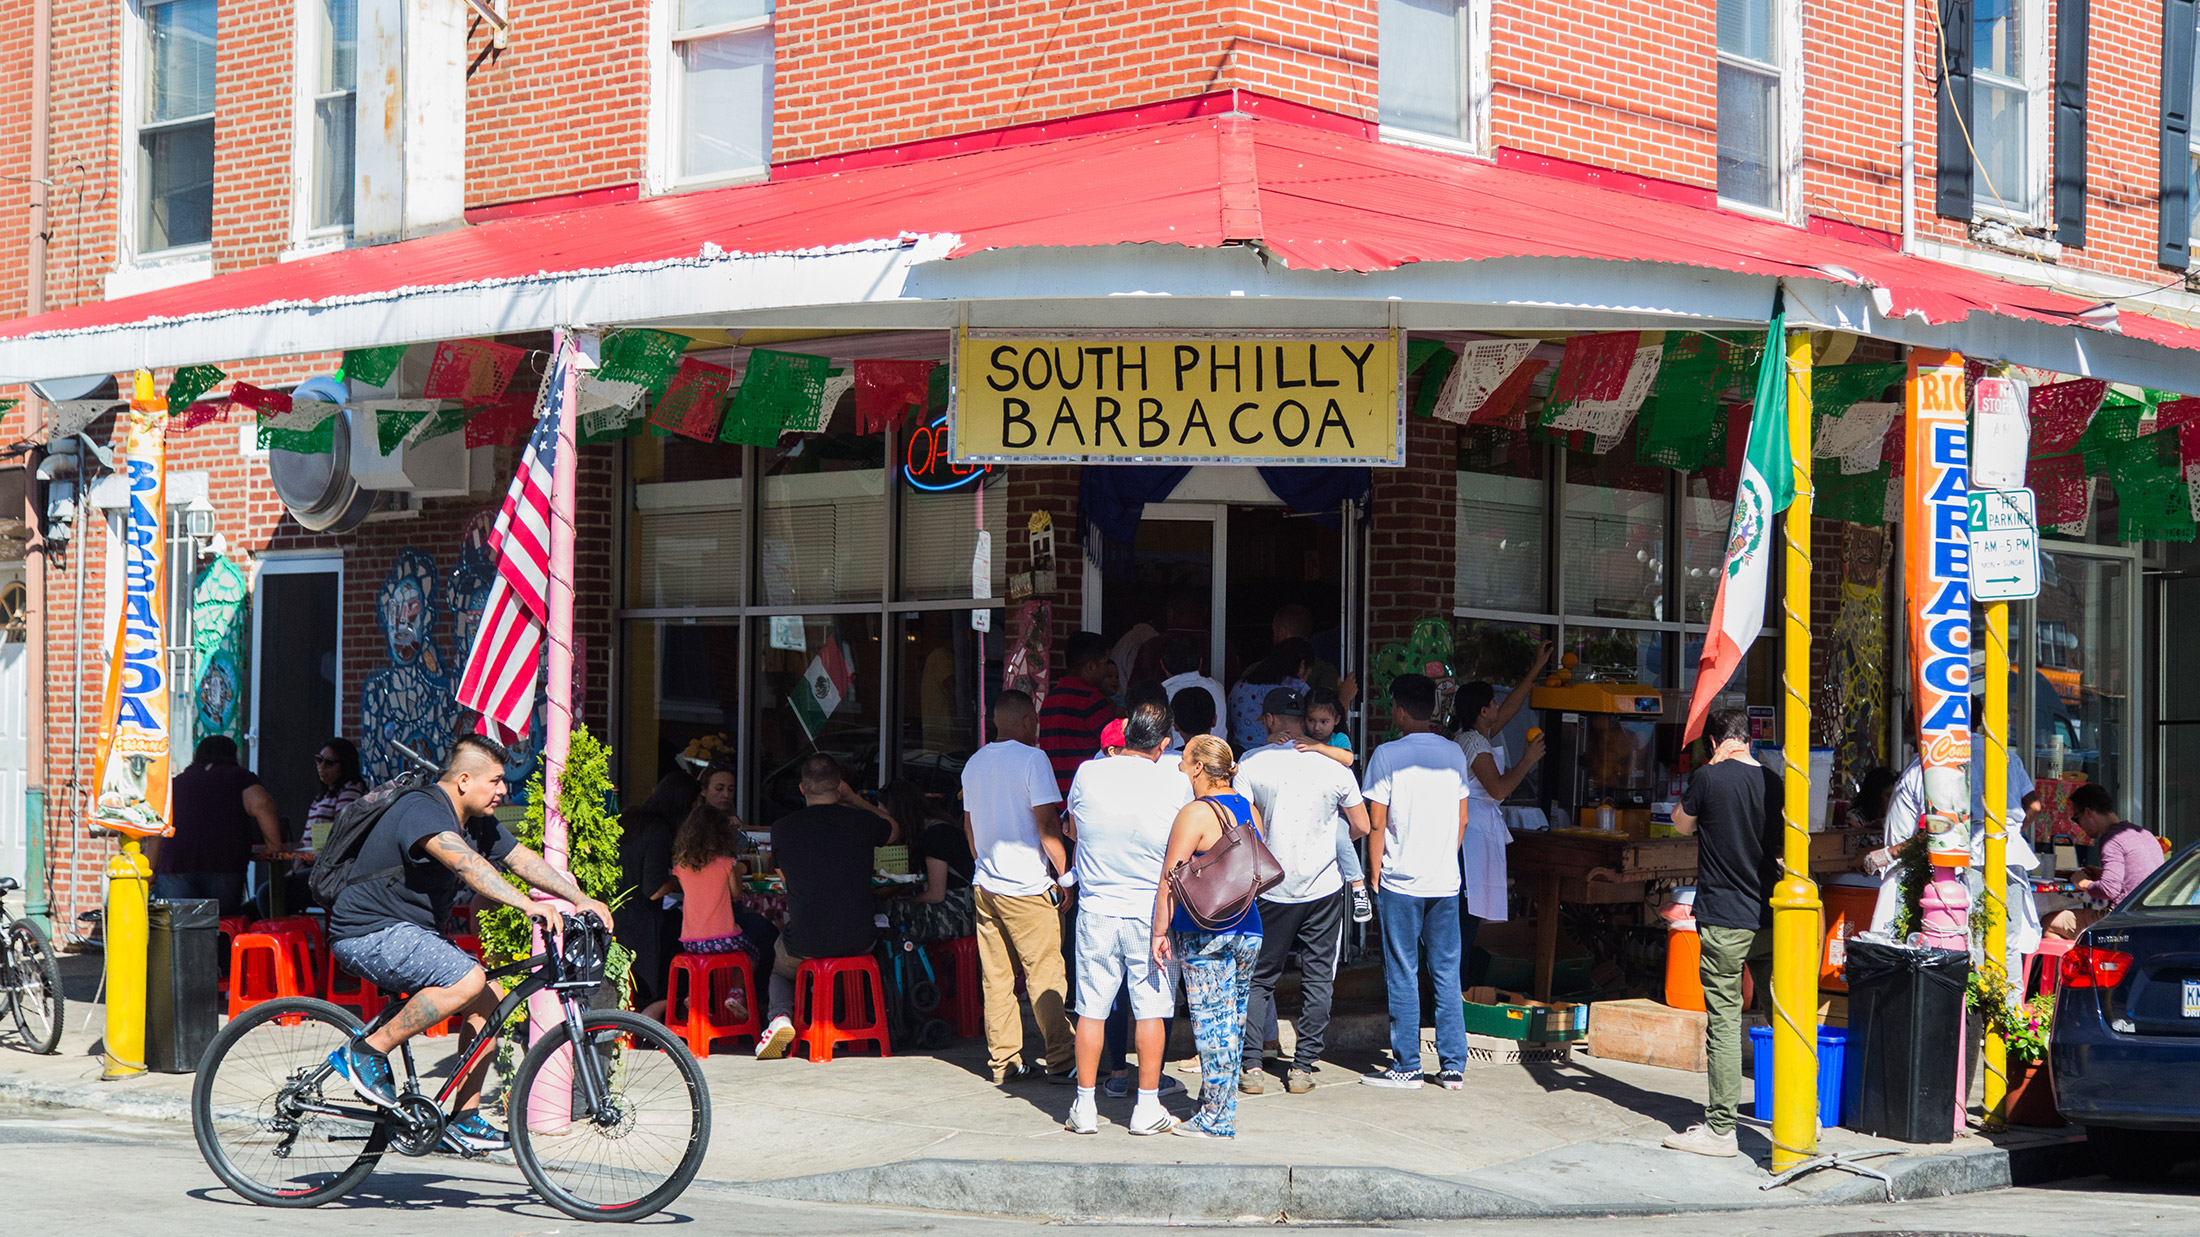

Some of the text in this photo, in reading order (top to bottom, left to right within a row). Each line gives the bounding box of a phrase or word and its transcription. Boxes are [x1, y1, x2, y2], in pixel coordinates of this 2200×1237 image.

[986, 343, 1376, 393] SOUTH PHILLY
[1002, 396, 1355, 448] BARBACOA
[1970, 499, 1983, 527] 2
[1989, 512, 2030, 527] PARKING
[1973, 541, 1979, 552] 7
[1984, 540, 1997, 552] AM
[2006, 539, 2012, 552] 5
[2016, 538, 2030, 551] PM
